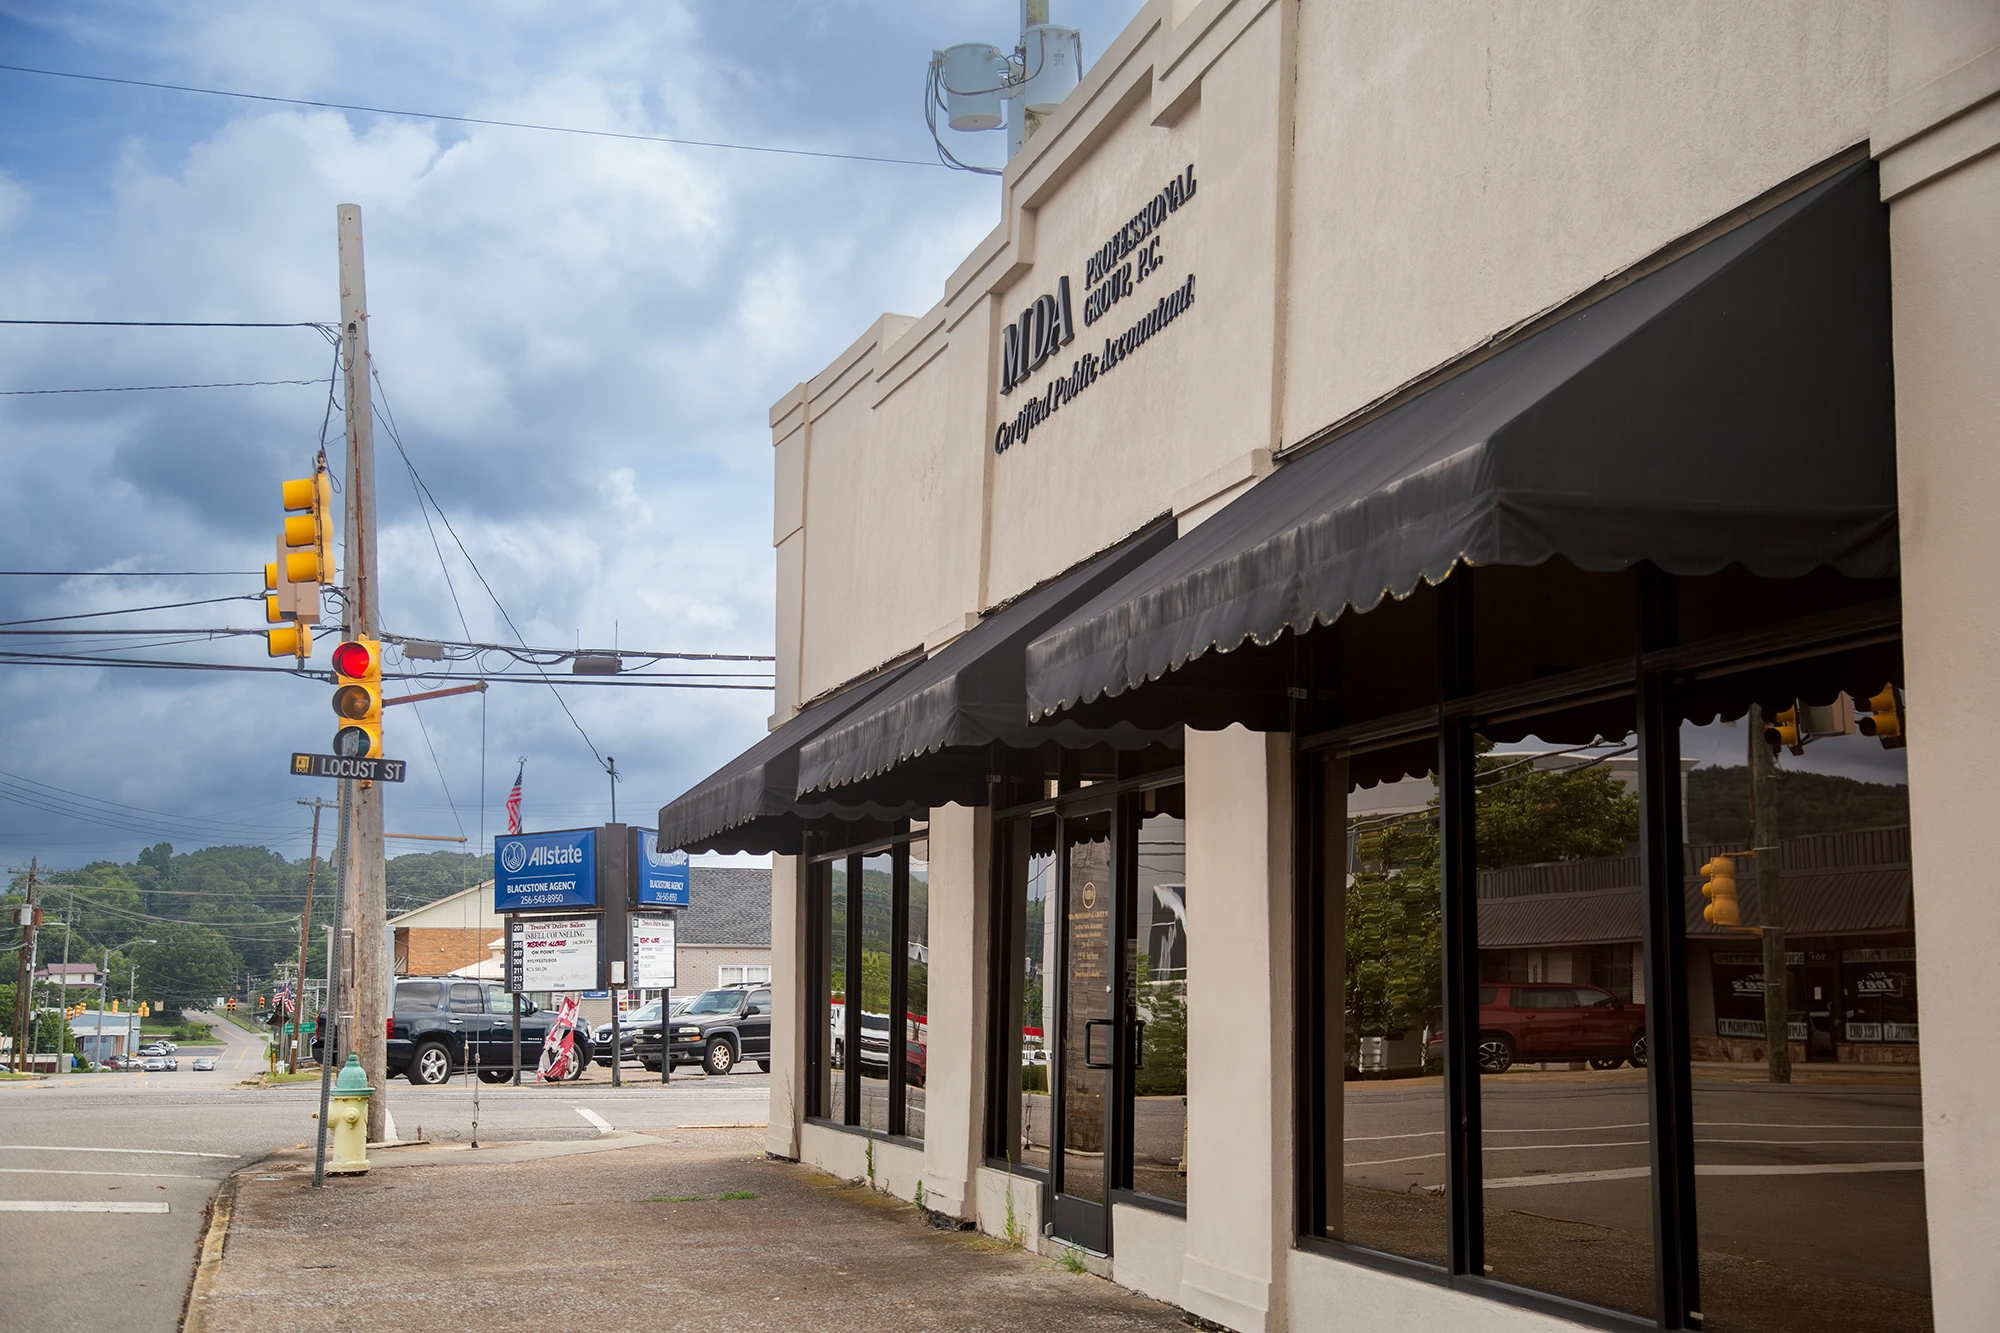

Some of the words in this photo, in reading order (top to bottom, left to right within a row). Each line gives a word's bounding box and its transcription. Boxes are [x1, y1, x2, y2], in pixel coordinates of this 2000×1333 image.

[1084, 164, 1197, 290] PROFESSIONAL
[1000, 275, 1075, 396] MDA
[994, 381, 1052, 455] Certified
[1051, 353, 1099, 413] Public
[322, 758, 377, 778] LOCUST
[384, 764, 402, 780] ST
[528, 844, 582, 866] Allstate
[507, 882, 548, 894] BLACKSTONE
[549, 881, 576, 891] AGENCY
[650, 880, 671, 889] BLACKSTONE
[671, 881, 684, 890] AGENCY
[521, 894, 564, 904] 256-543-8950
[547, 930, 584, 939] COUNSELING
